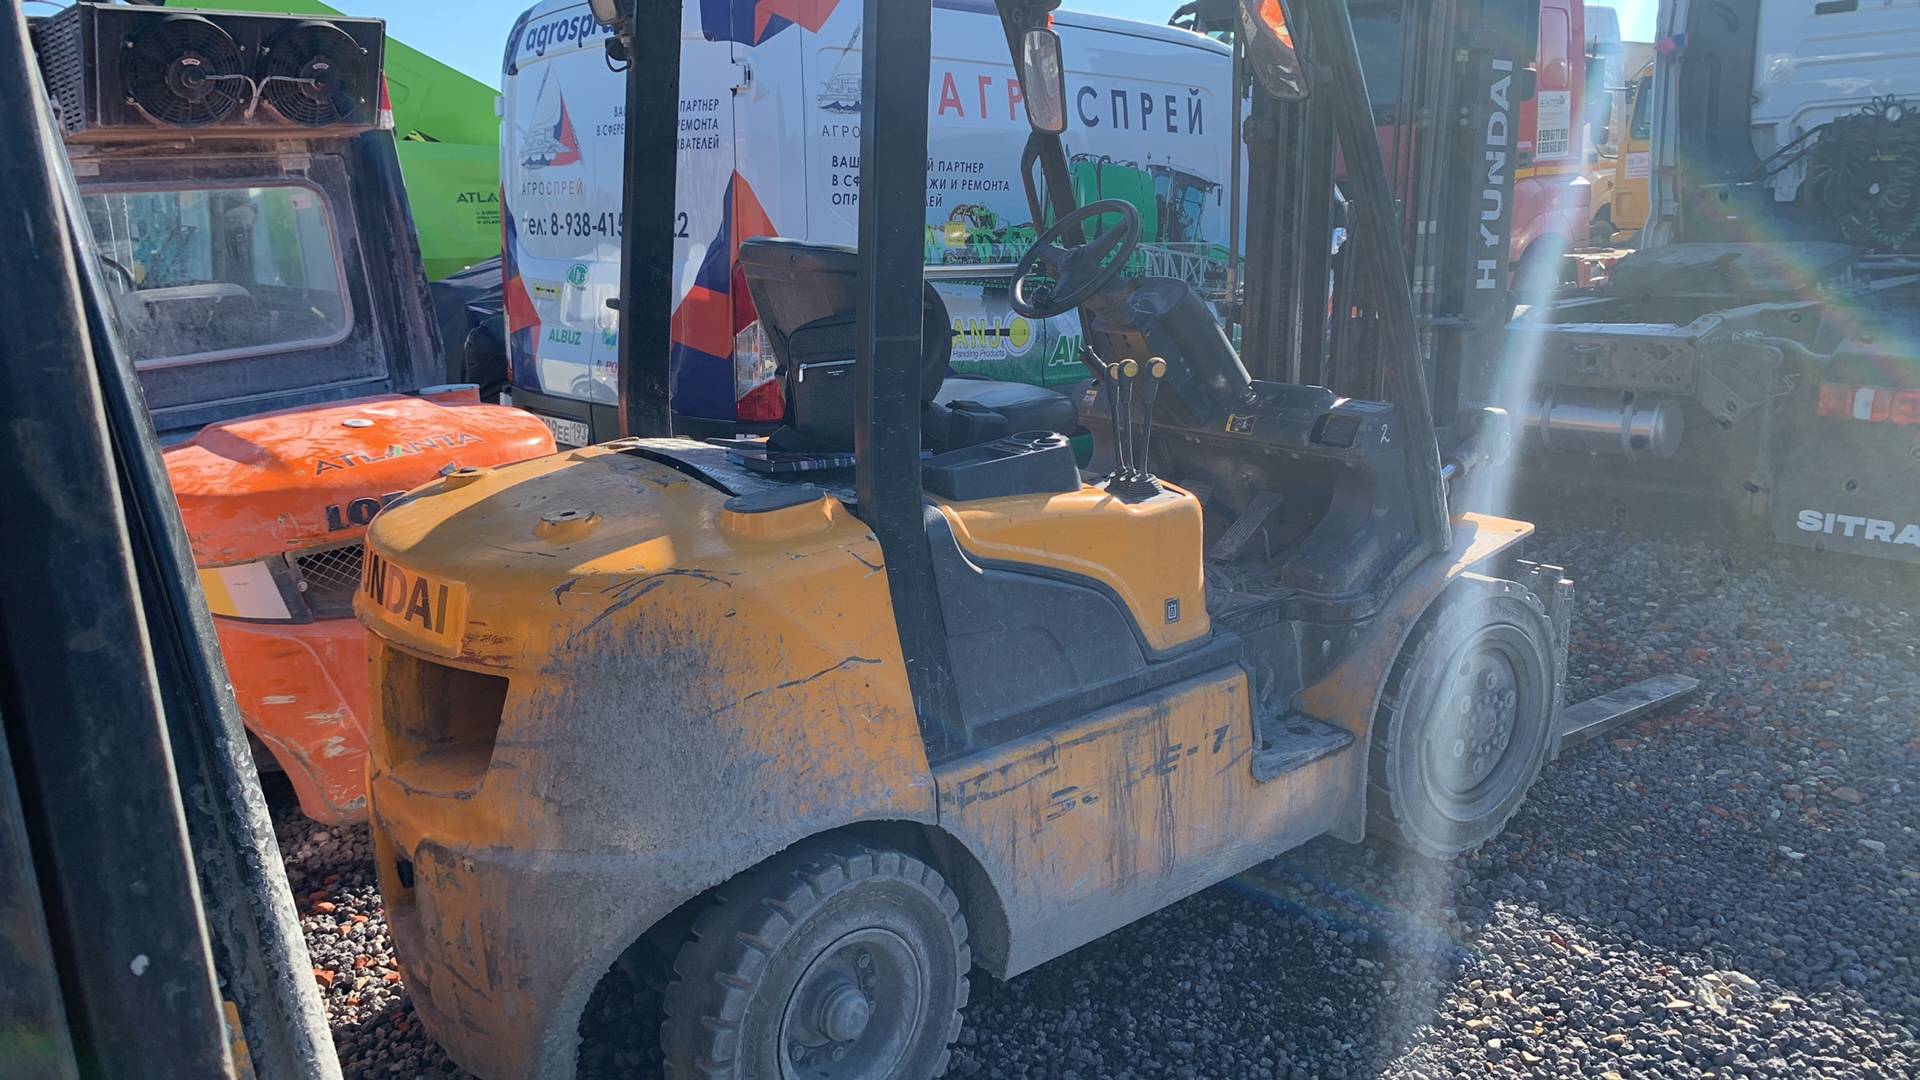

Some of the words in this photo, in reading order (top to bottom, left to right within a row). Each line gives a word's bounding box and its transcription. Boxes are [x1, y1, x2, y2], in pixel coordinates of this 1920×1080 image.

[680, 99, 720, 112] ПАРТНЕР
[938, 160, 985, 173] ПАРТНЕР
[1476, 59, 1513, 289] HYUNDAI
[521, 178, 584, 196] АГРОСПРЕЙ
[832, 175, 839, 186] В
[951, 179, 958, 190] И
[961, 179, 1010, 192] РЕМОНТА
[548, 328, 582, 346] ALBUZ
[953, 349, 979, 360] Handling
[980, 350, 1005, 359] Products
[315, 432, 483, 476] ATLANTA
